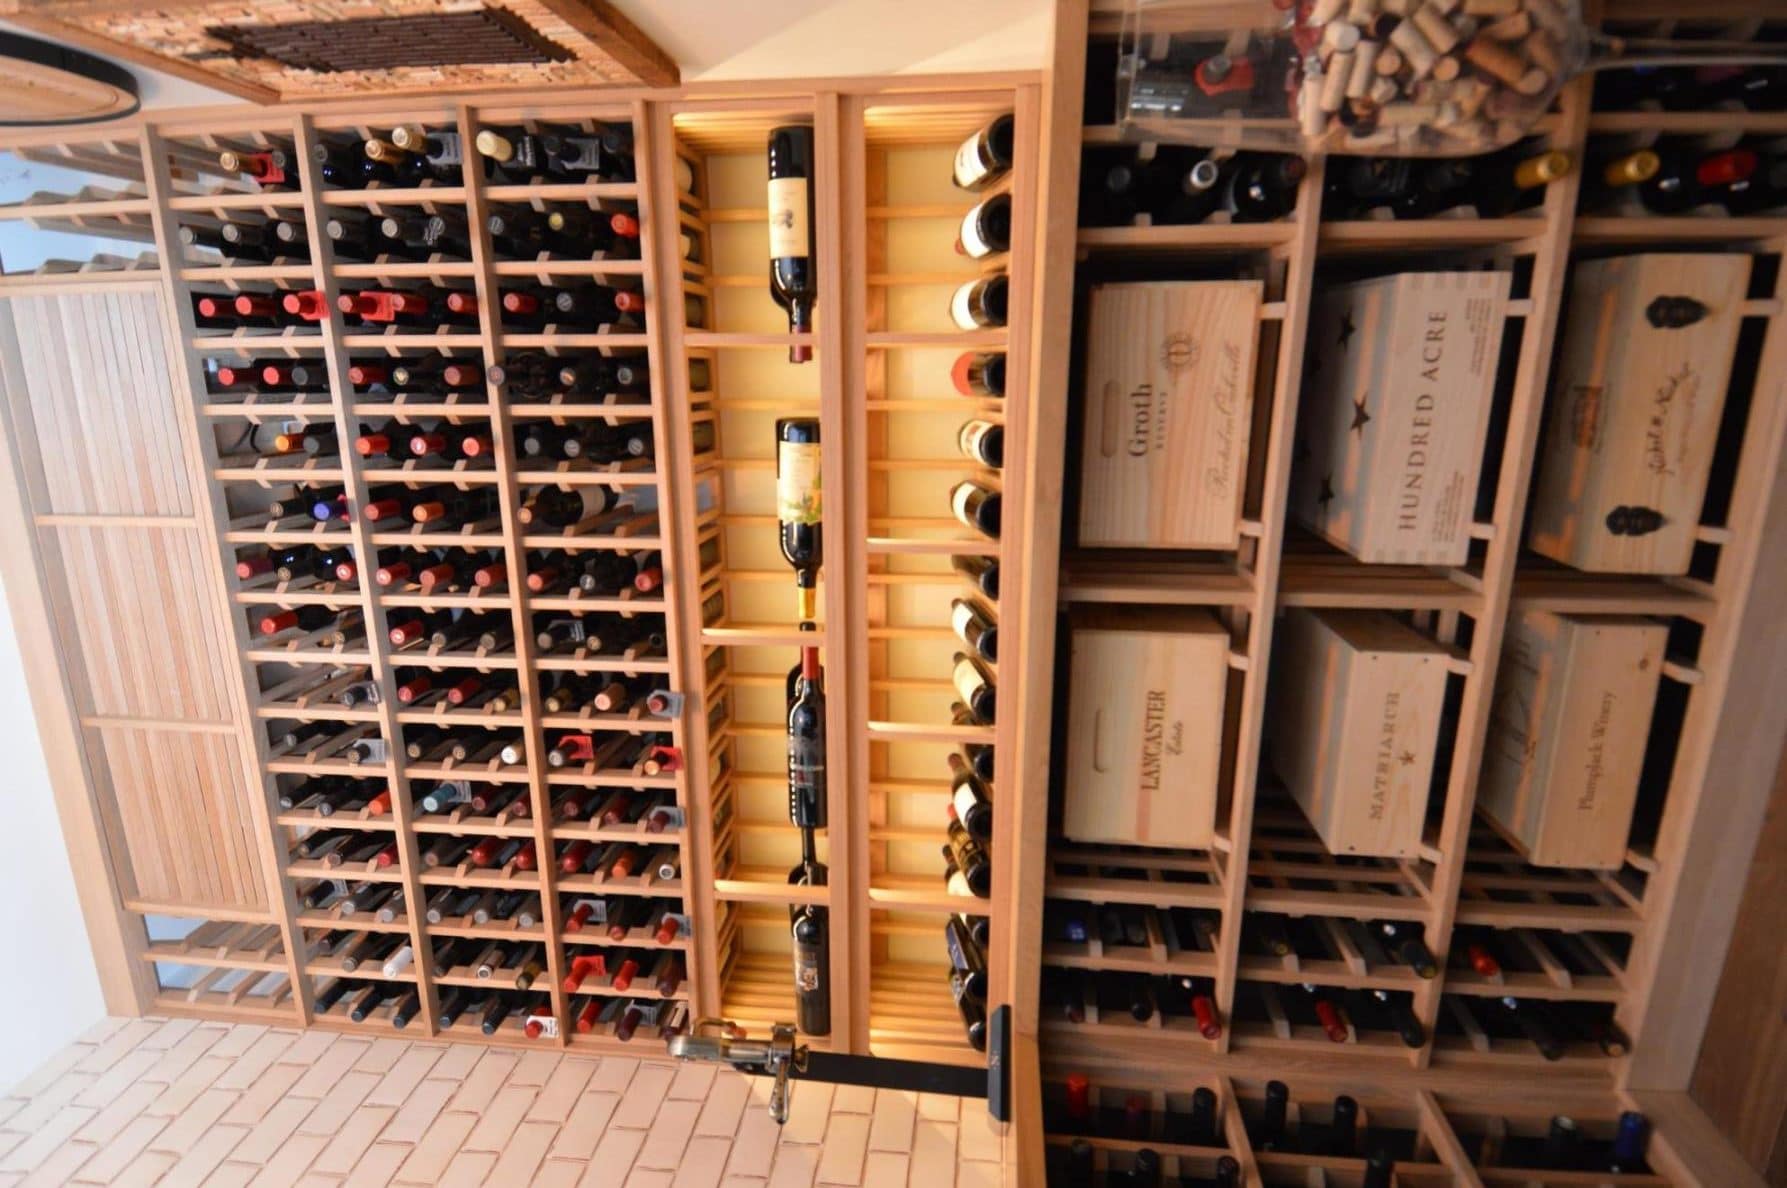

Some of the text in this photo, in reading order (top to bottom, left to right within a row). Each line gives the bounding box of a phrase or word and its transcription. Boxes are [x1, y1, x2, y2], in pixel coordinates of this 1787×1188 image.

[1127, 383, 1152, 457] Groth
[1397, 310, 1448, 531] HUNDRED ACRE
[1140, 690, 1167, 790] LANCASTER
[1368, 691, 1400, 821] MATRIARCH
[1590, 691, 1616, 739] Winery
